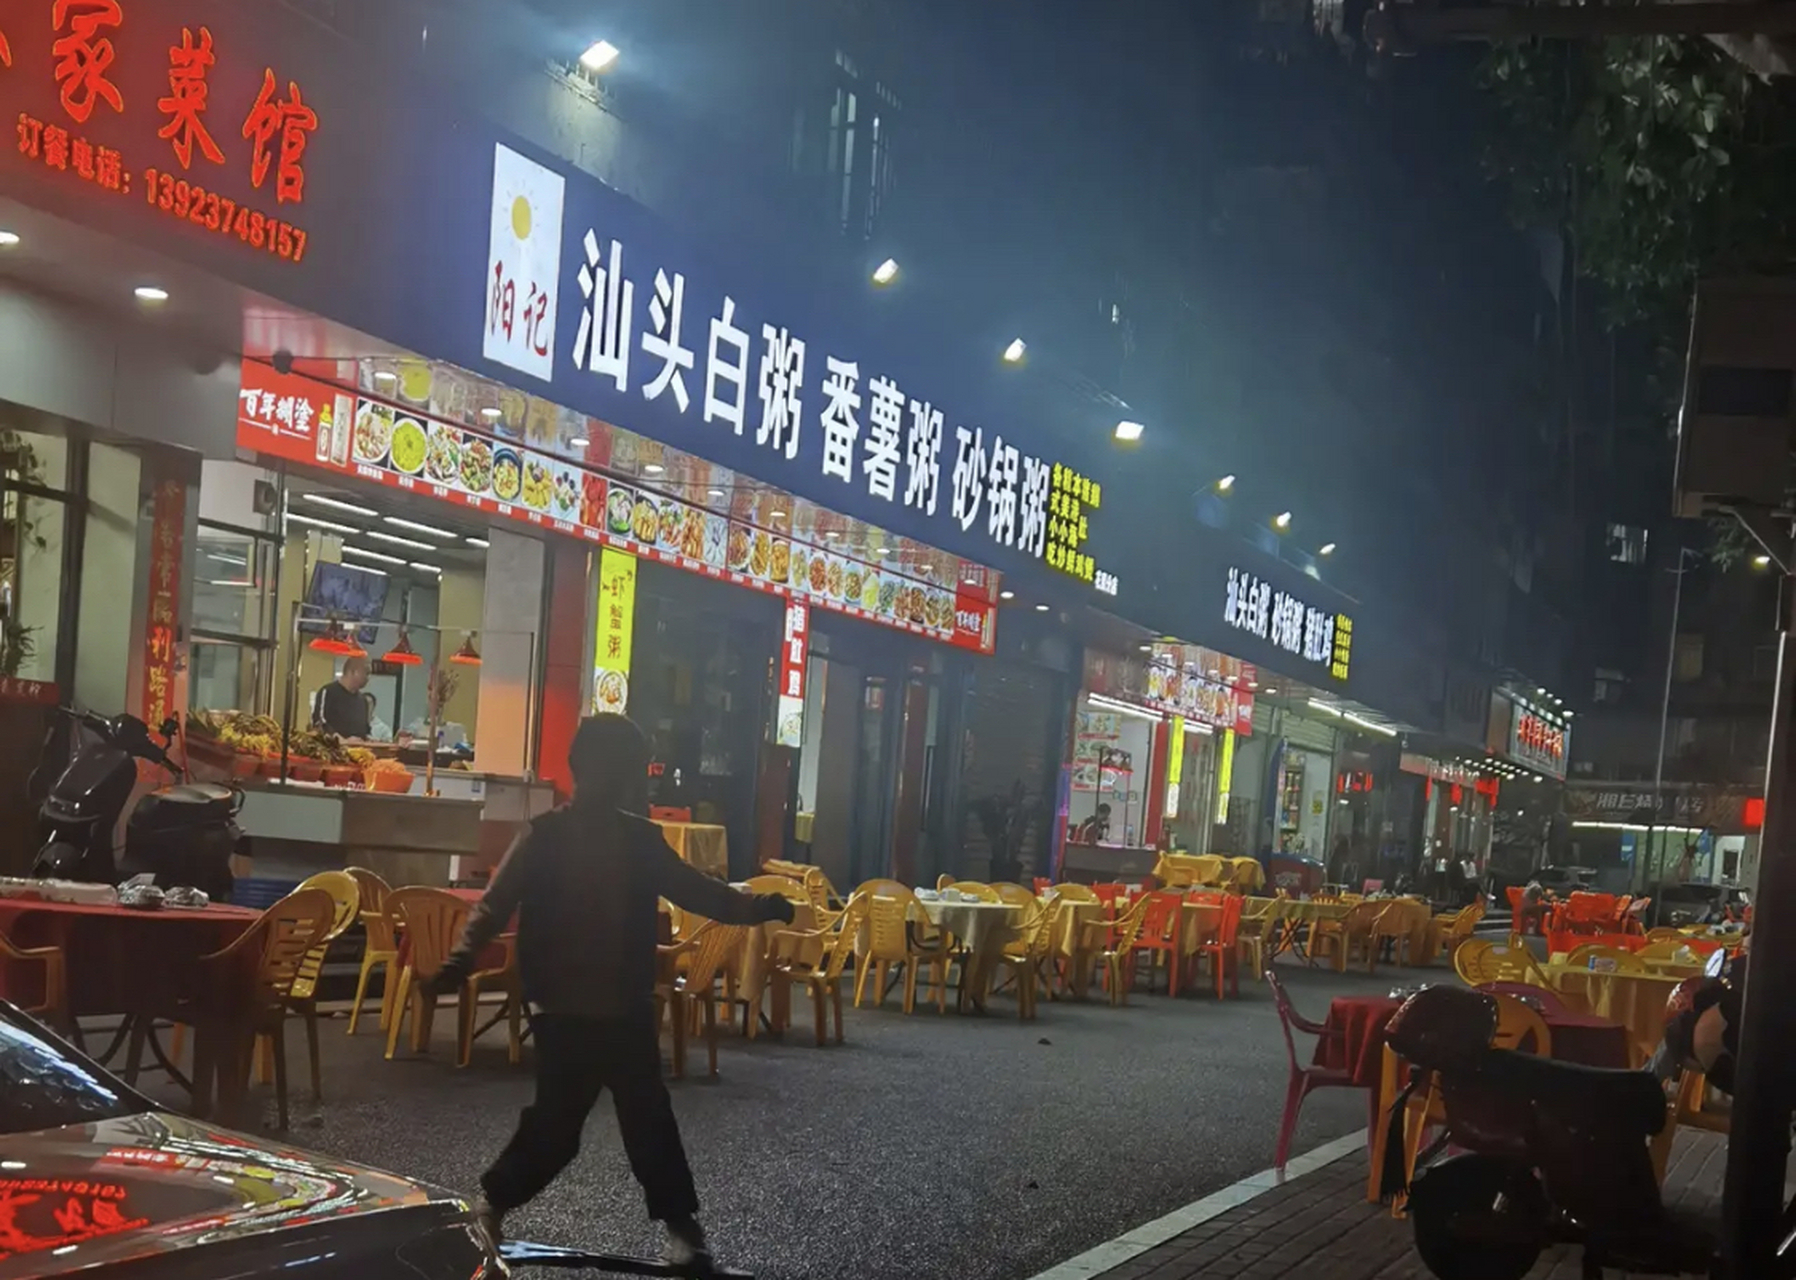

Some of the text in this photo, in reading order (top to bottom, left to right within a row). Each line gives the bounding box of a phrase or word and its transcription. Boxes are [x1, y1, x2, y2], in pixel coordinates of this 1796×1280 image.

[0, 0, 317, 205] 家菜馆
[145, 168, 307, 261] 13923748157
[491, 260, 548, 357] 阳记
[573, 227, 1050, 558] 汕头白粥 番薯粥 砂锅粥
